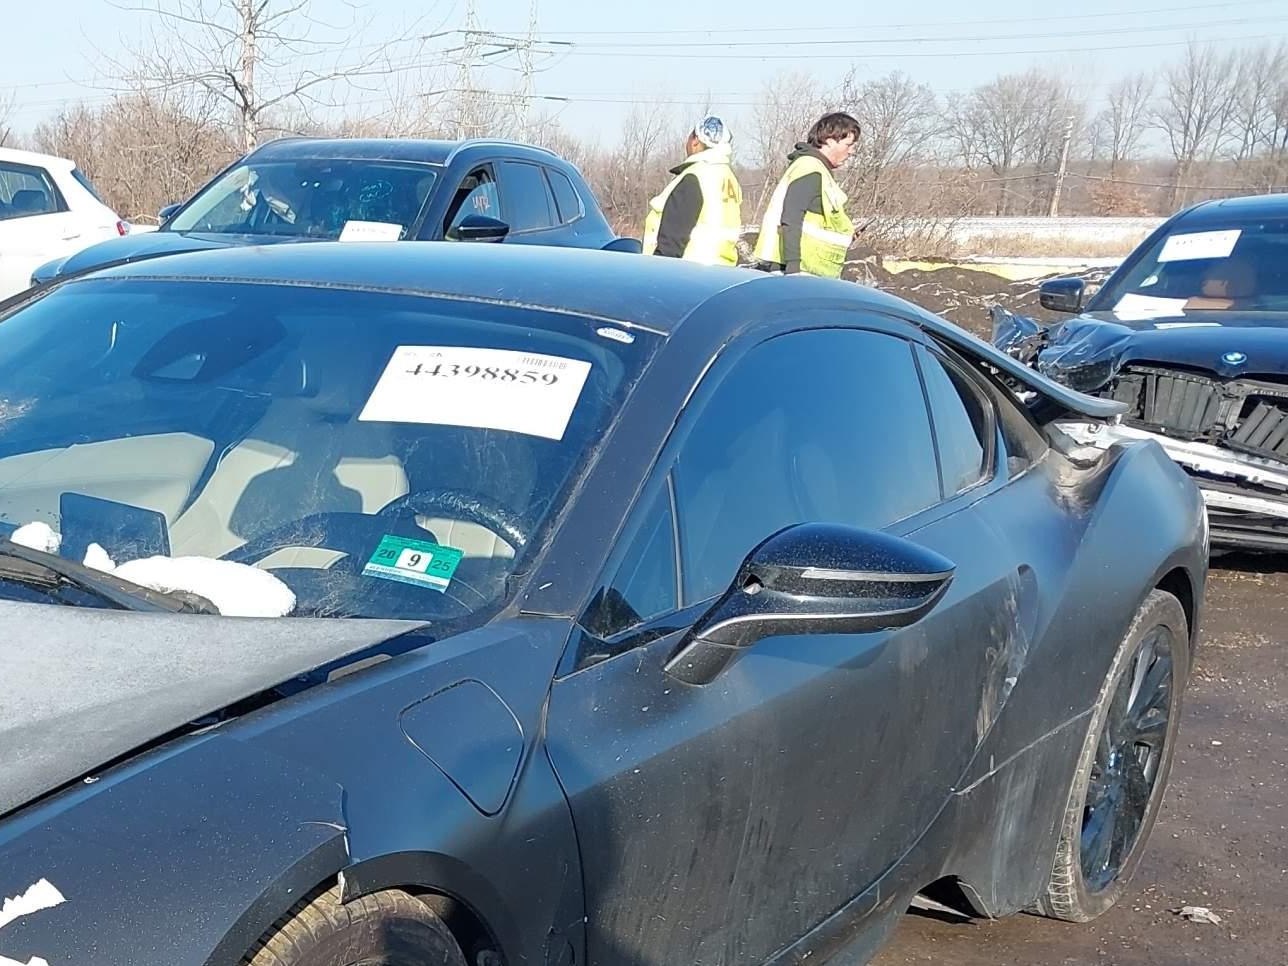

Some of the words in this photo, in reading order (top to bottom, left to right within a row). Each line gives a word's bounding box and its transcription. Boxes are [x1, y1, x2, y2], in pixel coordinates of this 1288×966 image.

[404, 362, 560, 387] 44398859
[376, 548, 397, 560] 20
[407, 553, 422, 568] 9
[431, 559, 452, 572] 25
